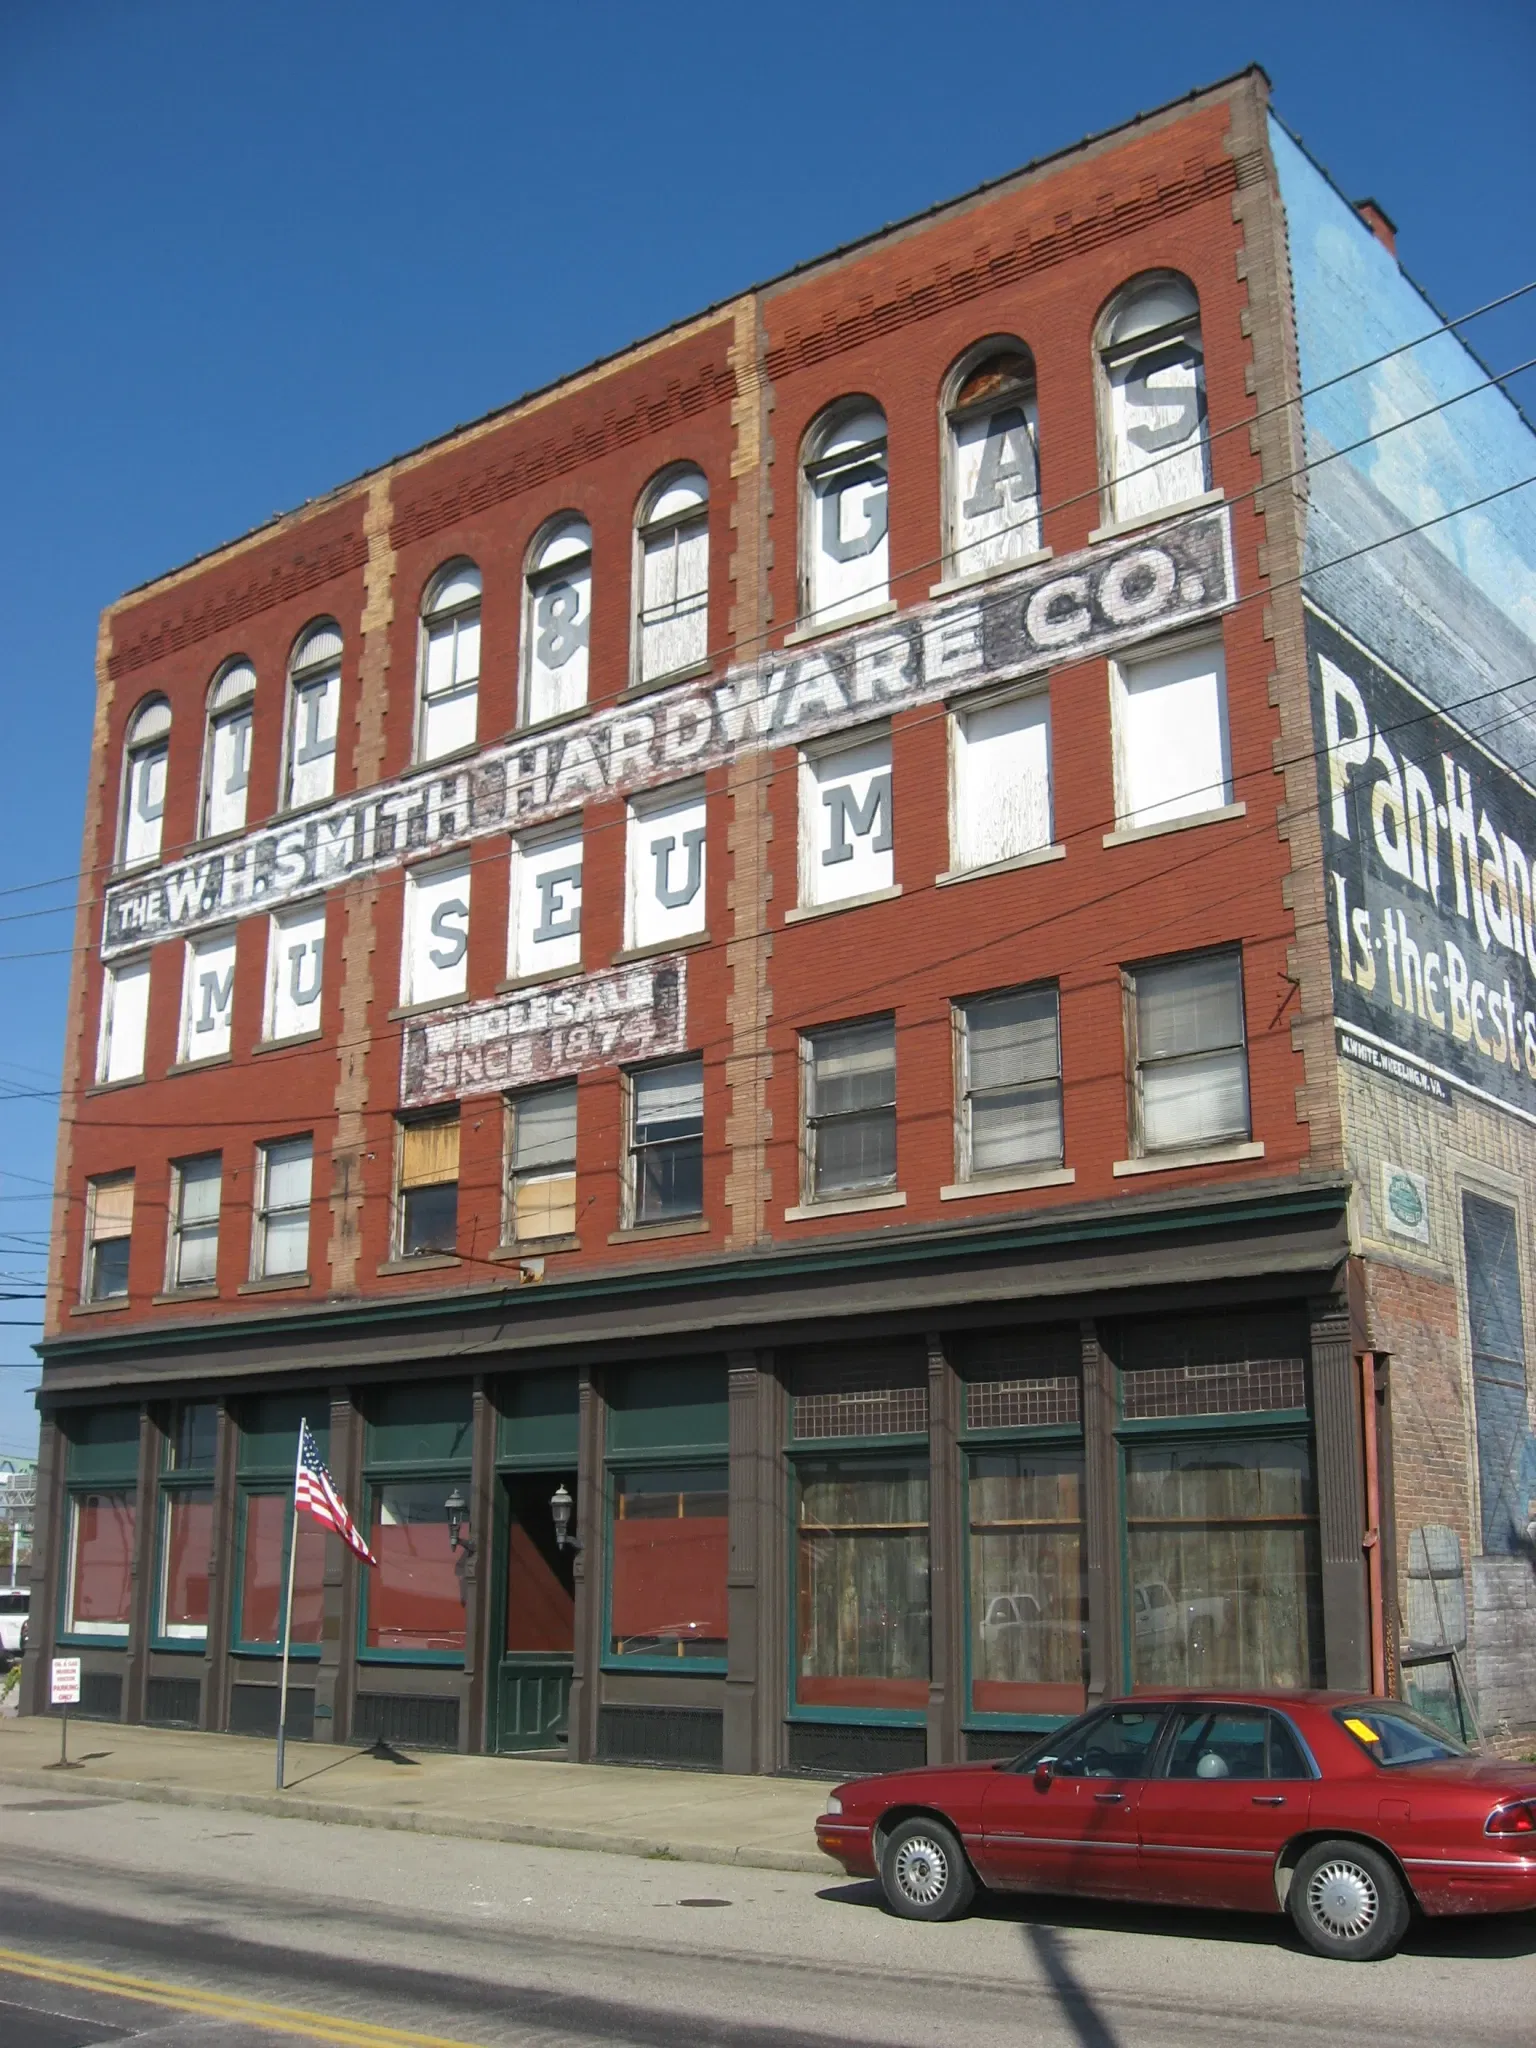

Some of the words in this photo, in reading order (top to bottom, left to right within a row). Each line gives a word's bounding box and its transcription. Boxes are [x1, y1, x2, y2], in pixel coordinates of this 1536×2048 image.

[536, 578, 590, 671] &
[820, 341, 1207, 564] GAS
[118, 896, 162, 931] THE
[274, 774, 472, 889] SMITH
[503, 602, 984, 818] HARDWARE
[1023, 547, 1206, 651] CO.
[422, 1036, 533, 1089] SINCE
[549, 1010, 657, 1068] 1874
[424, 966, 655, 1054] WHOLESALE
